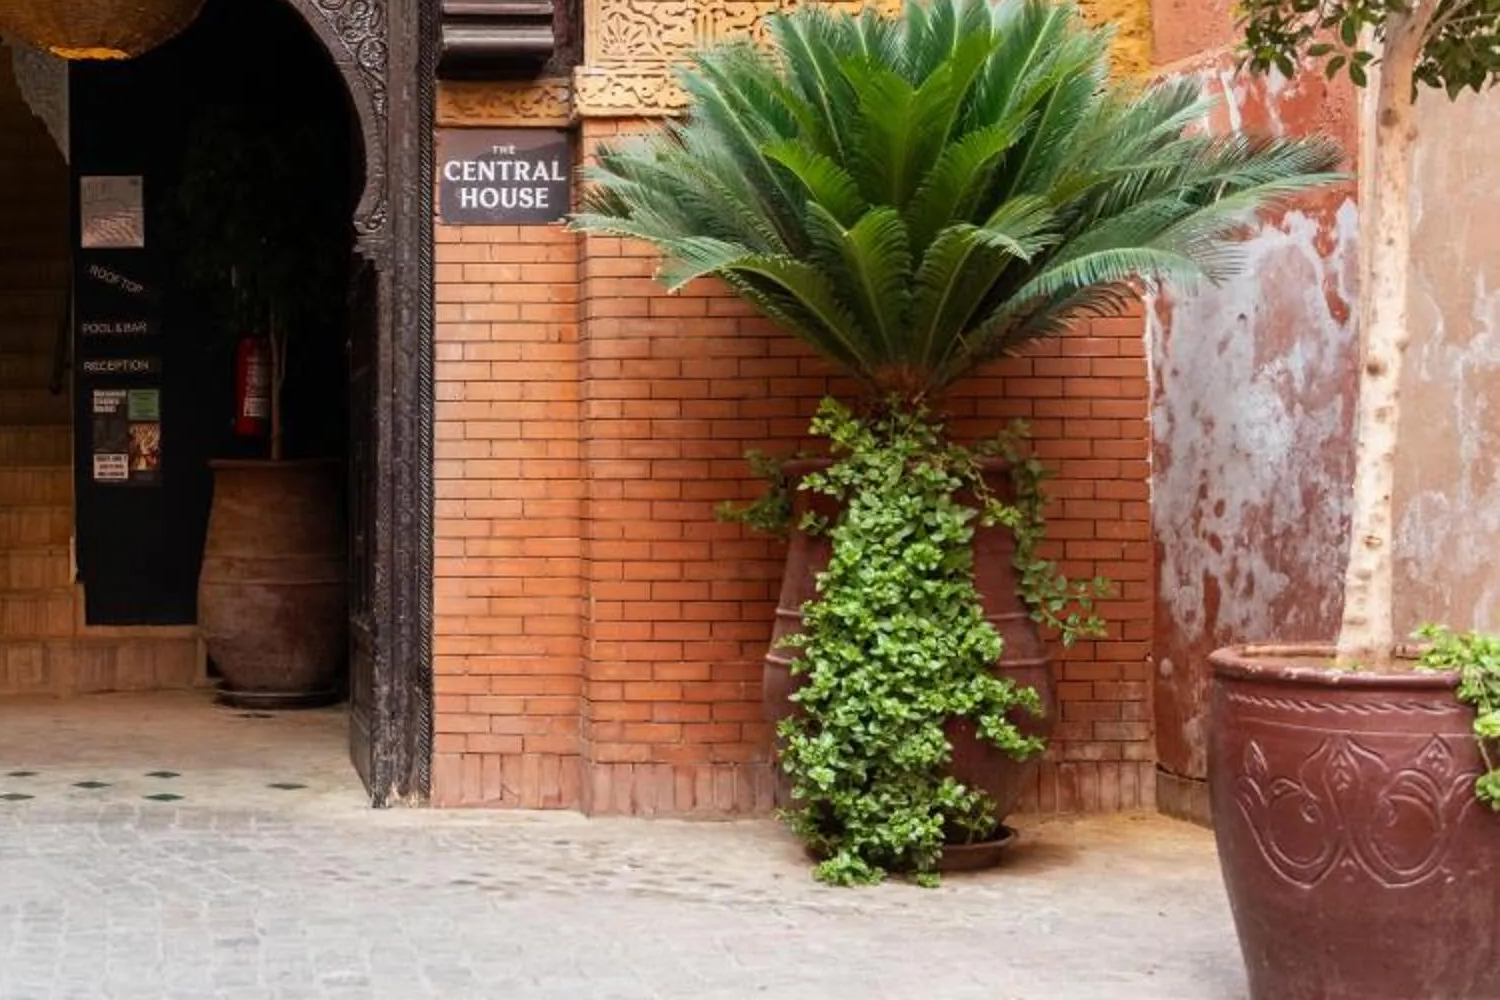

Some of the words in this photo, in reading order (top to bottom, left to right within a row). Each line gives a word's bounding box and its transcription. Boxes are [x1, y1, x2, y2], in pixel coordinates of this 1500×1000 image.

[492, 145, 516, 155] THE
[444, 160, 566, 181] CENTRAL
[461, 187, 549, 209] HOUSE
[83, 360, 149, 372] RECEPTION
